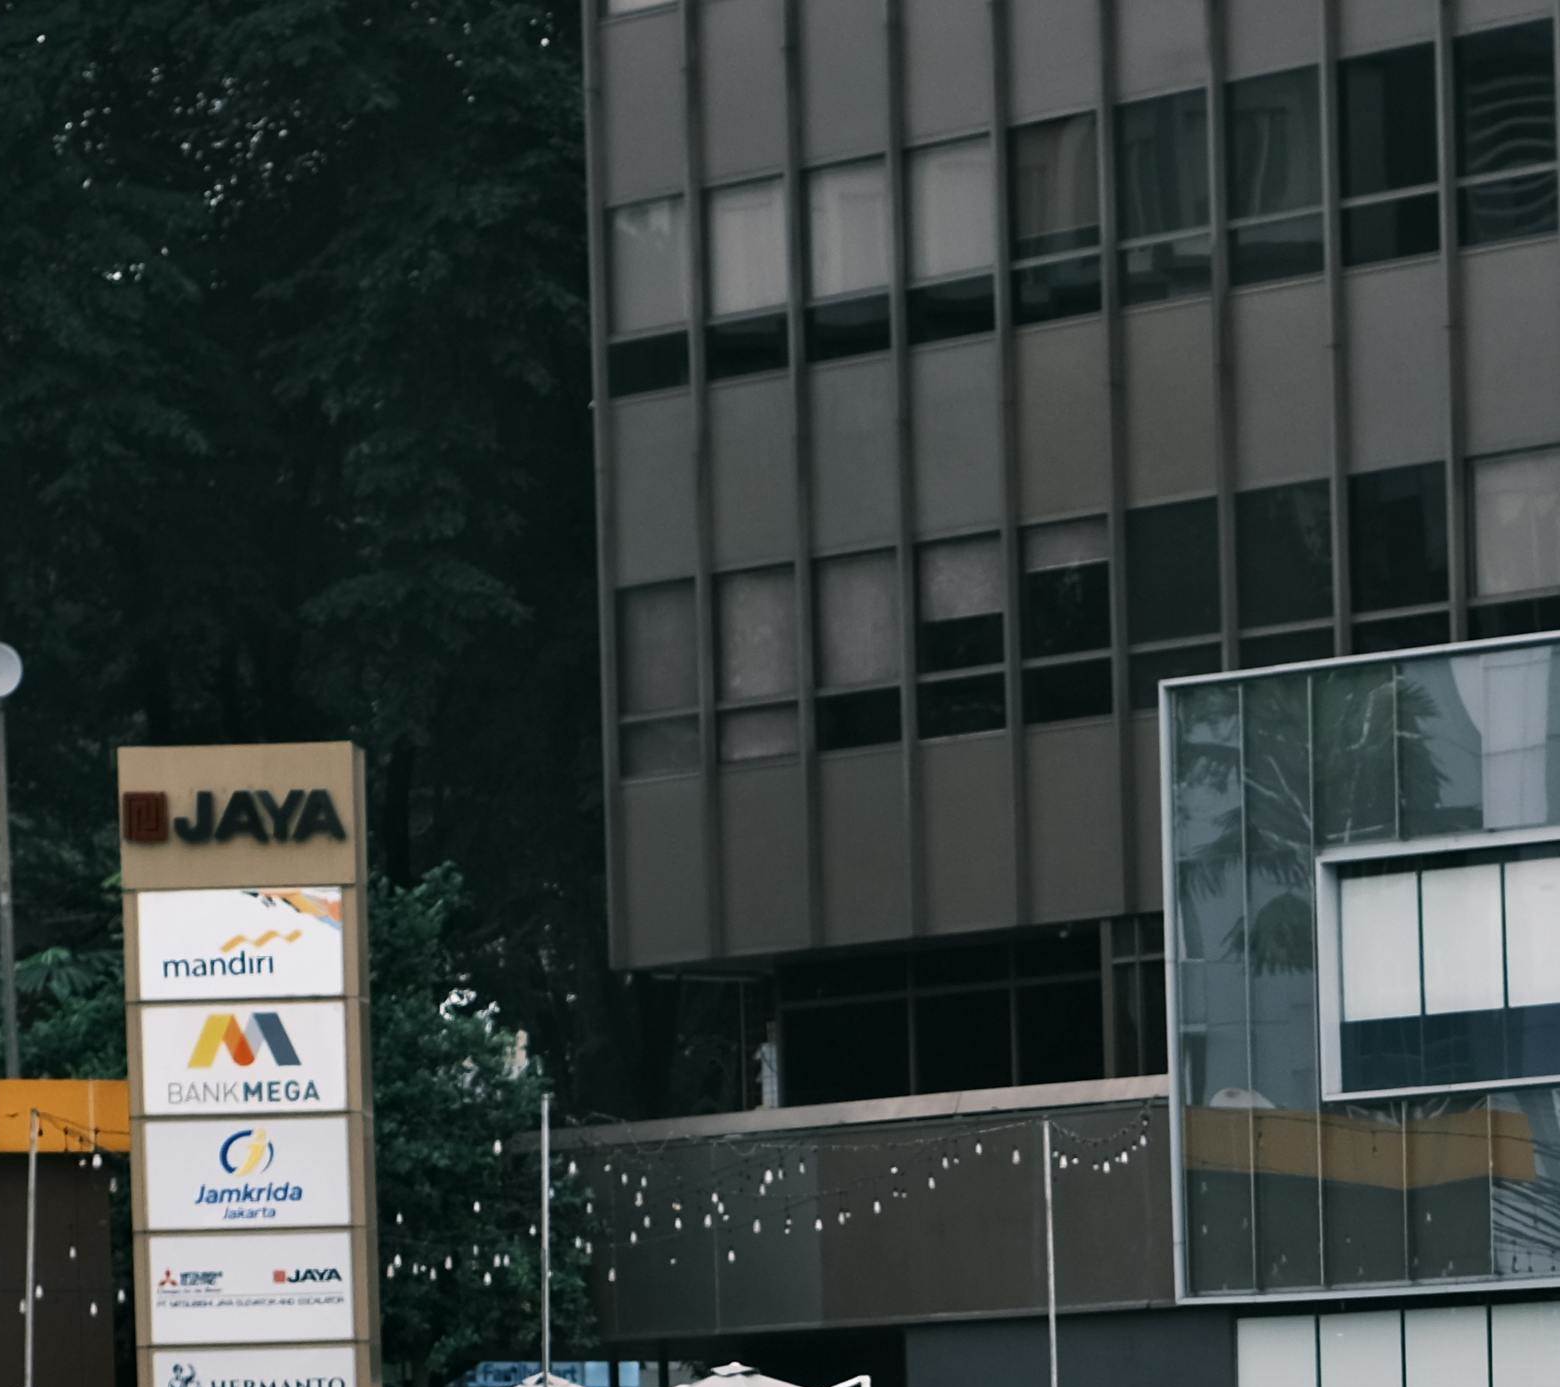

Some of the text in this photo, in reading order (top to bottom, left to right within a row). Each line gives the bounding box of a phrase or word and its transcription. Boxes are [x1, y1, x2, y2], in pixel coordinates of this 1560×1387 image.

[174, 789, 347, 843] JAYA
[162, 951, 275, 978] mandiri
[195, 1182, 303, 1205] Jamkrida
[287, 1268, 342, 1283] JAYA
